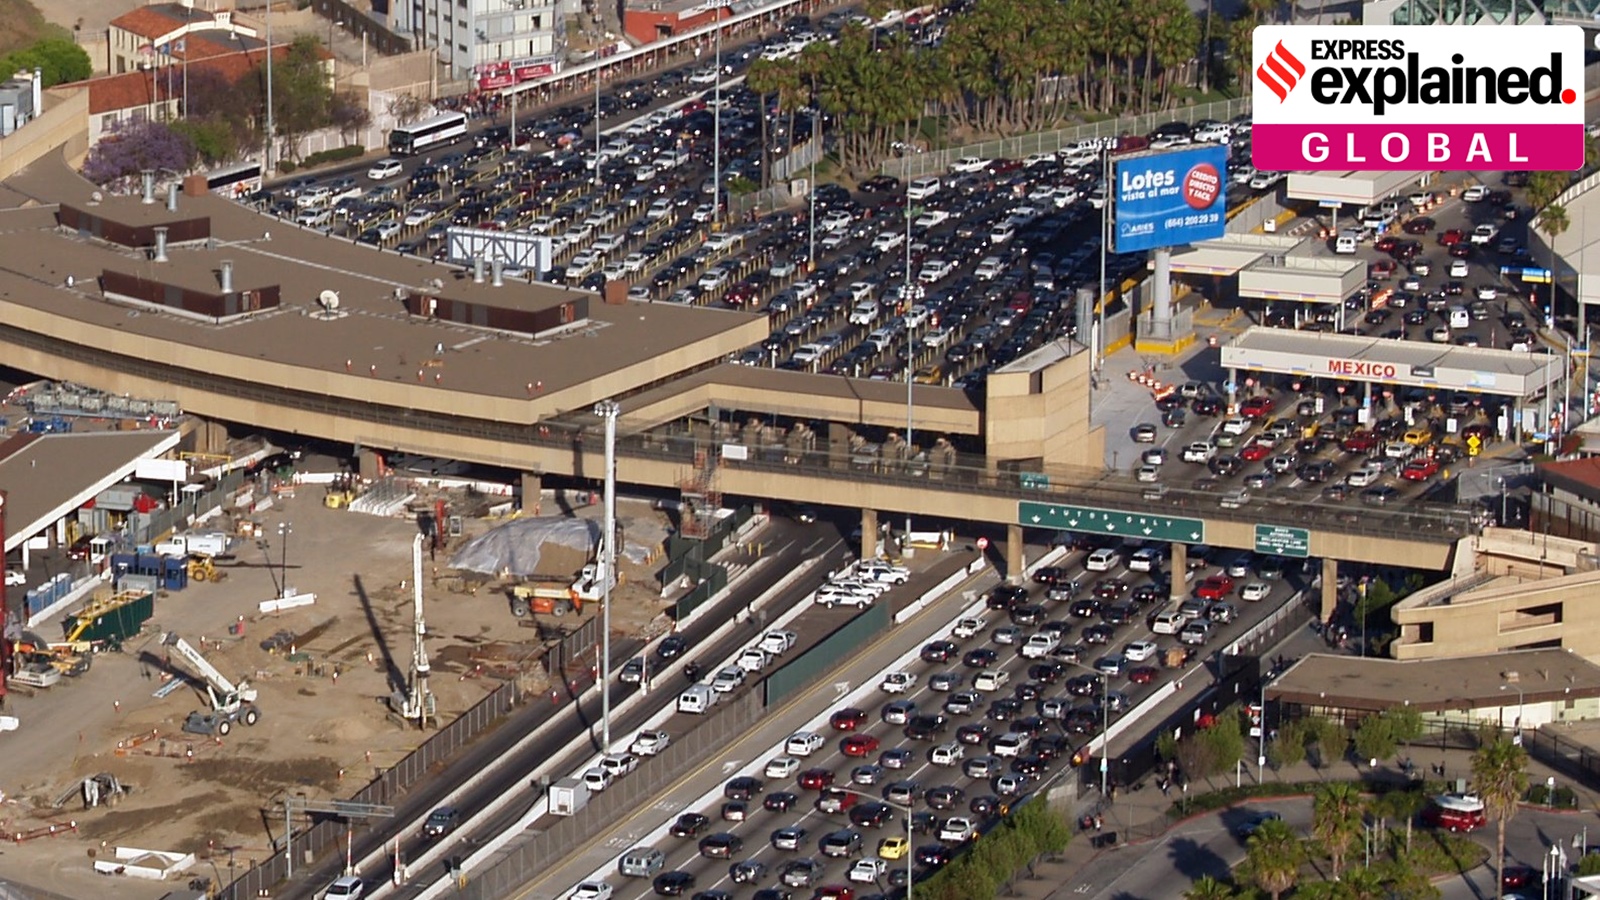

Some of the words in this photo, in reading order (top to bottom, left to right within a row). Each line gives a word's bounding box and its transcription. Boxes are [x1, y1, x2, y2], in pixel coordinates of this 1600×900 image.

[1122, 169, 1174, 192] Lotes
[1188, 179, 1216, 193] DIRECTO
[1121, 190, 1146, 202] vista
[1148, 187, 1158, 198] al
[1160, 186, 1180, 196] mar
[1188, 188, 1194, 197] Y
[1328, 360, 1396, 378] MEXICO
[1049, 508, 1109, 521] AUTOS
[1126, 516, 1172, 528] ONLY
